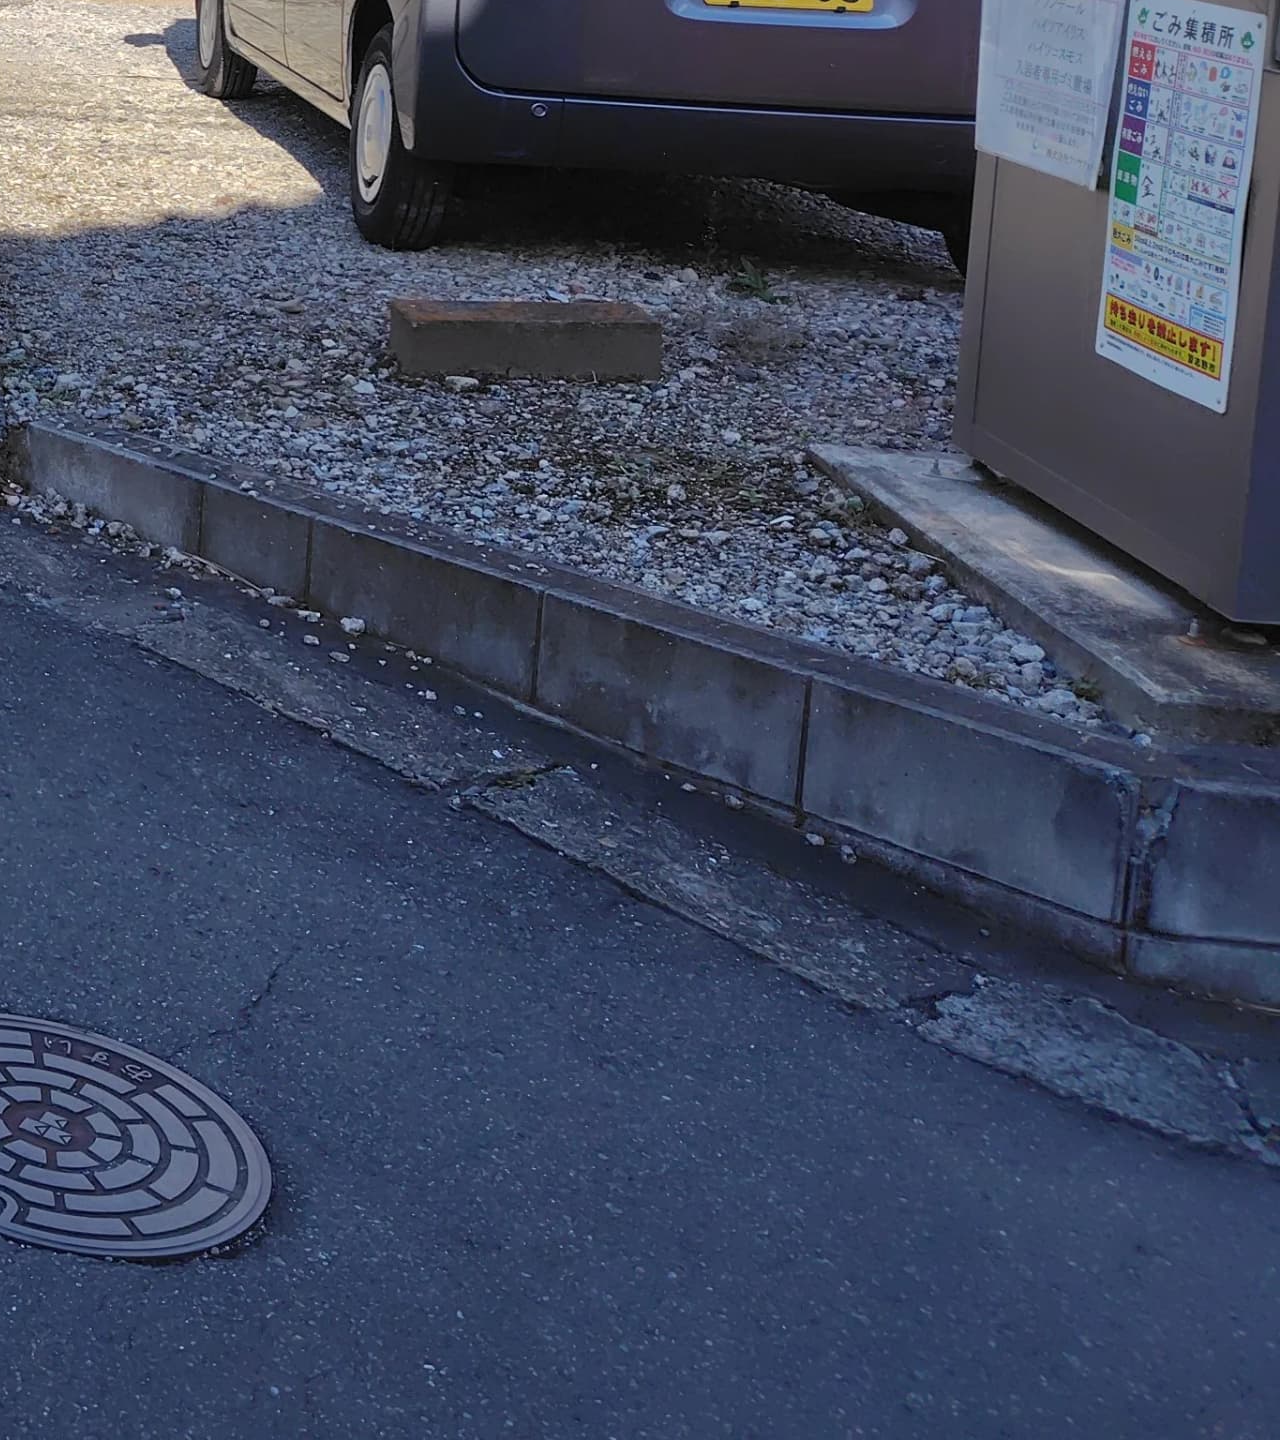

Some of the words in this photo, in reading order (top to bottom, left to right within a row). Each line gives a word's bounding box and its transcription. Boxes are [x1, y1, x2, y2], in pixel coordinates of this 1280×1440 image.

[1152, 11, 1236, 50] ごみ集積所
